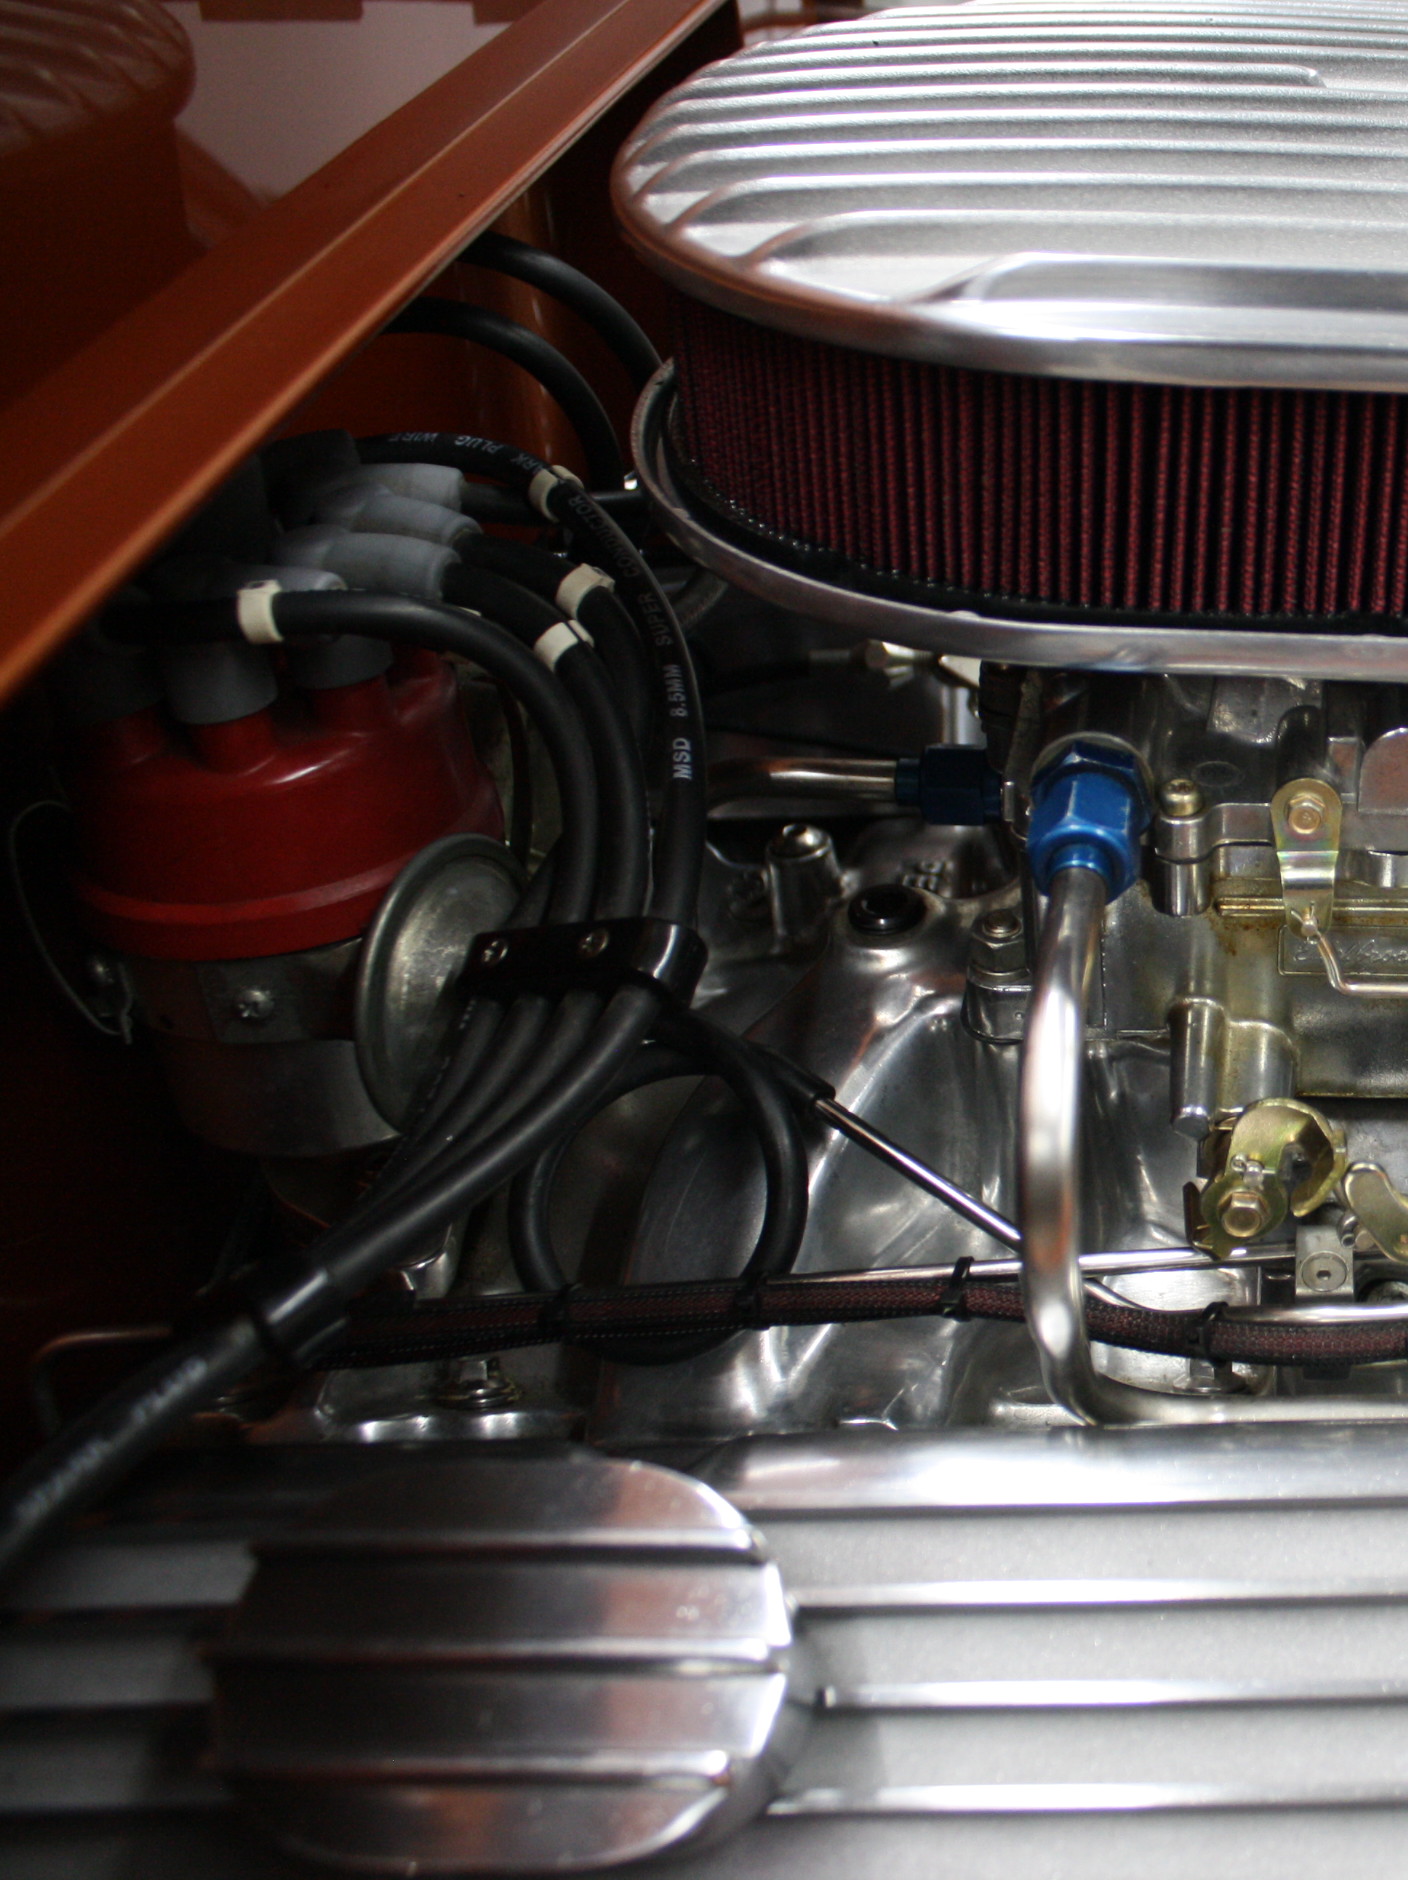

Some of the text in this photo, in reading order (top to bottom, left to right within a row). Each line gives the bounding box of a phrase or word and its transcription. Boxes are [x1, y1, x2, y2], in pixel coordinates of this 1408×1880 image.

[454, 434, 503, 455] PLUG
[568, 494, 640, 577] CONDUCTOR
[637, 592, 674, 647] SUPER
[664, 664, 689, 717] 8.5MM
[673, 737, 692, 780] MSD
